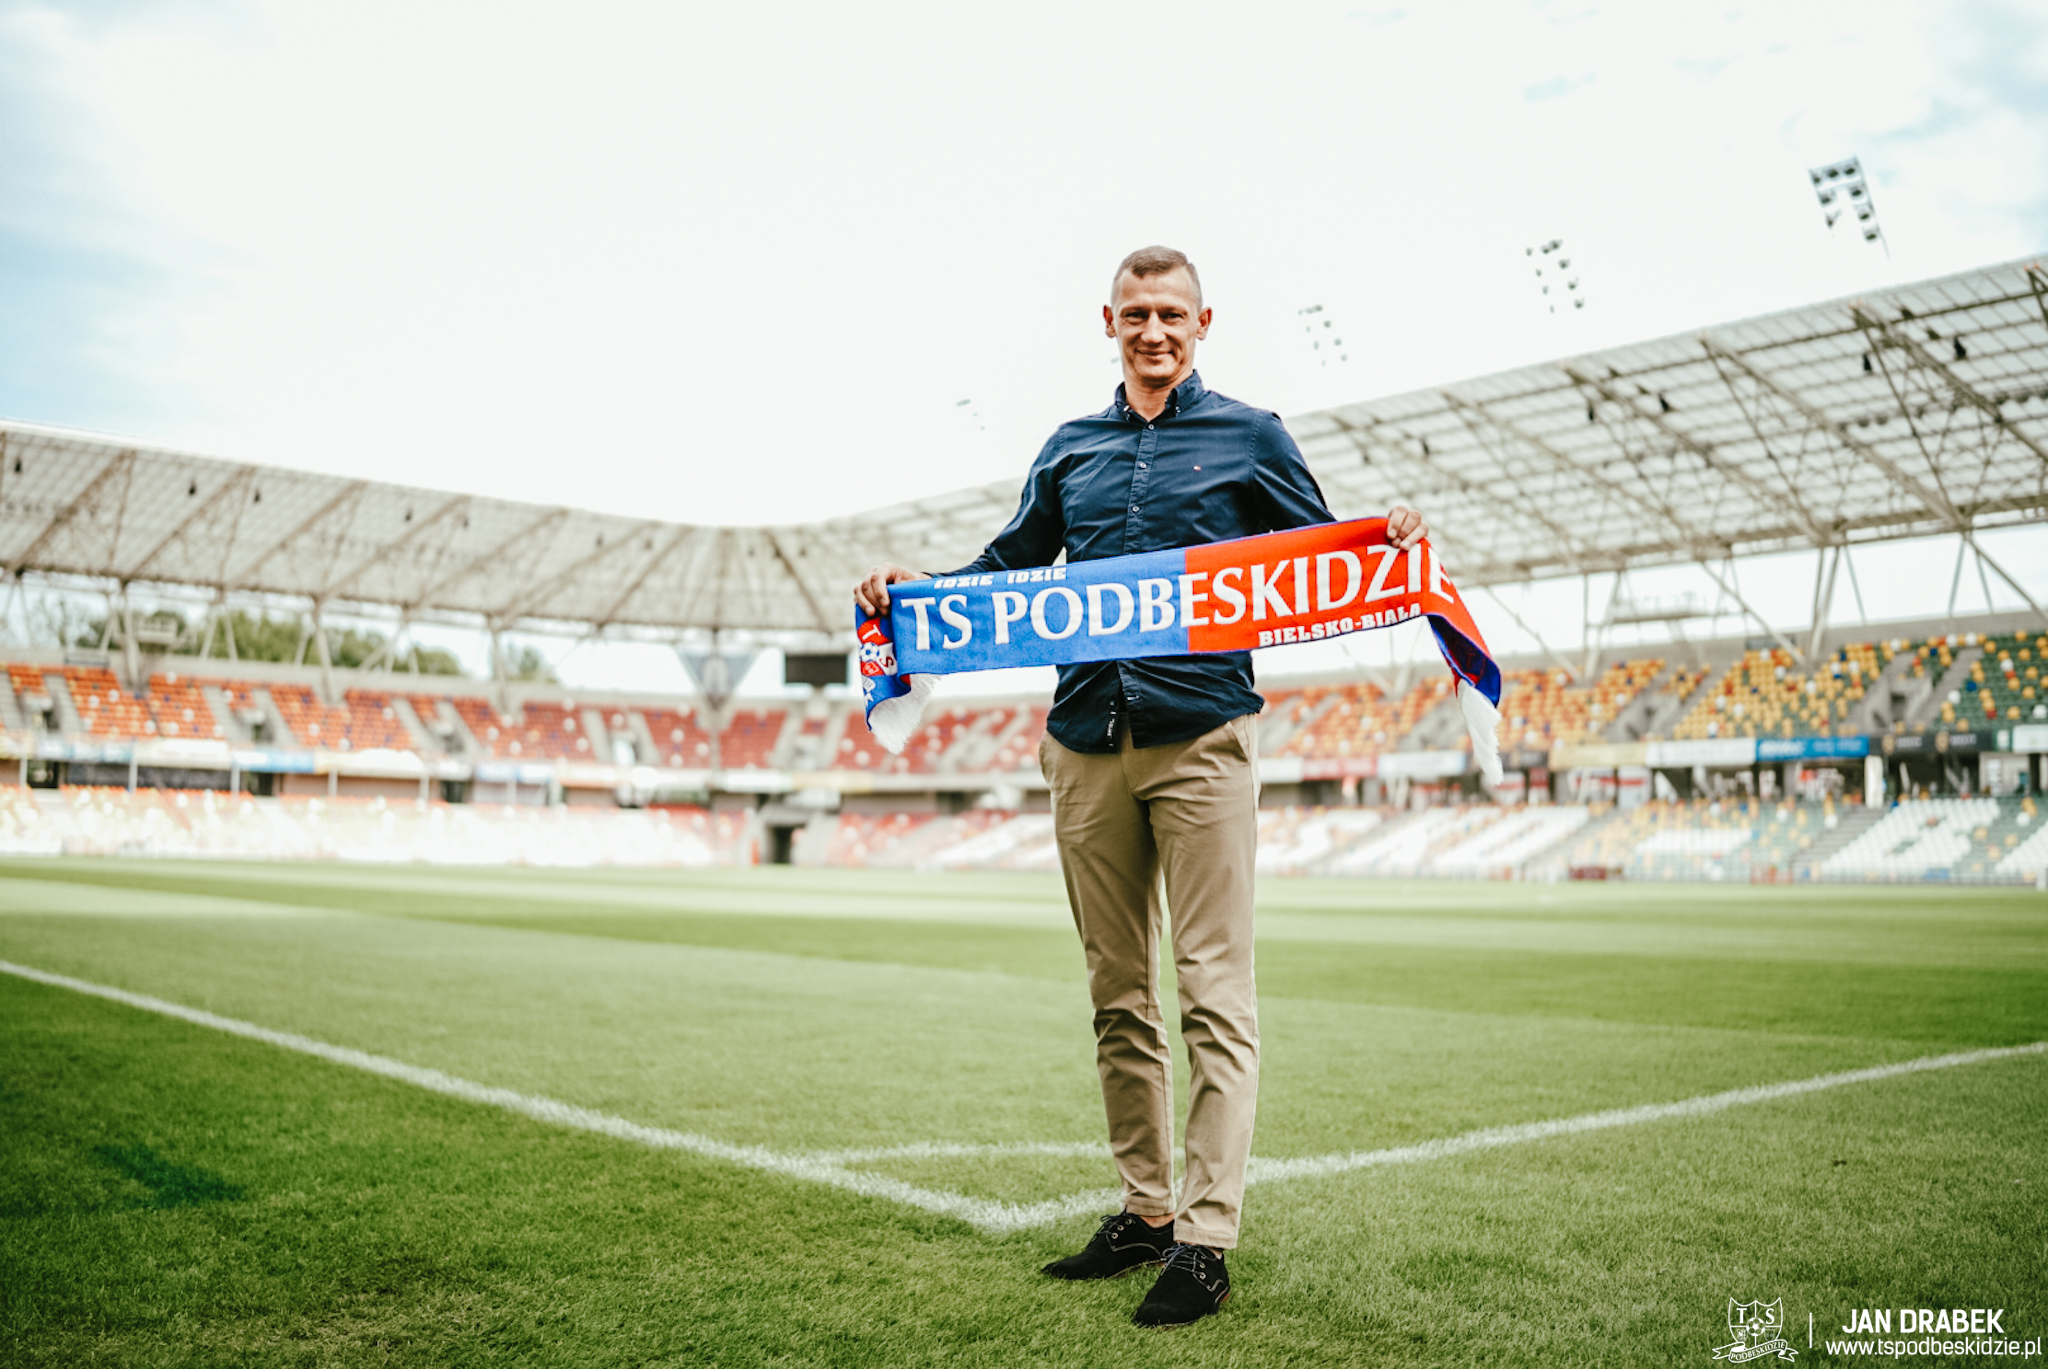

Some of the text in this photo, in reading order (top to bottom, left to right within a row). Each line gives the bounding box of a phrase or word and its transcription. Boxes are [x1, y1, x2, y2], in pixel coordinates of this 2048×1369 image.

[900, 543, 1455, 651] TS PODBESKIDZIE
[934, 567, 1067, 589] IDZIE IDZIE
[1258, 603, 1421, 647] BIELSKO-BIAŁA
